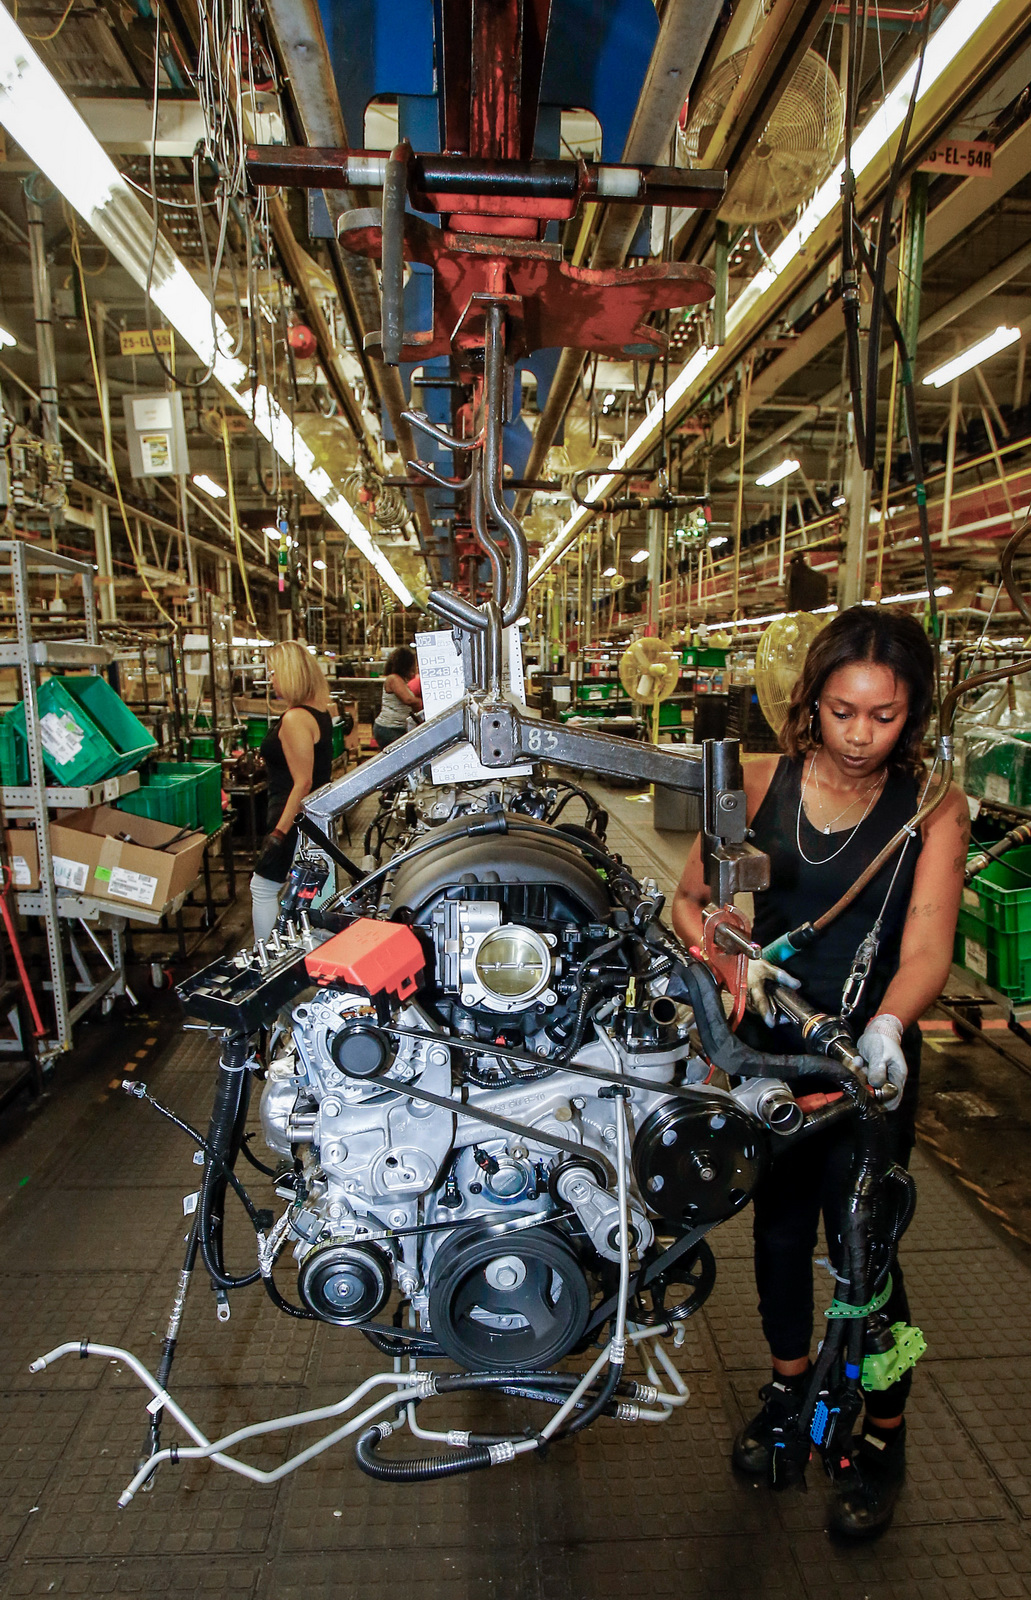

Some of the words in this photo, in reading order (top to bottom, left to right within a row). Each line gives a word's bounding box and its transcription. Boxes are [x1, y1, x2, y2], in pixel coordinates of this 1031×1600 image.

[925, 146, 992, 169] 5-EL-54R
[421, 667, 450, 678] 2248
[529, 728, 558, 751] 83
